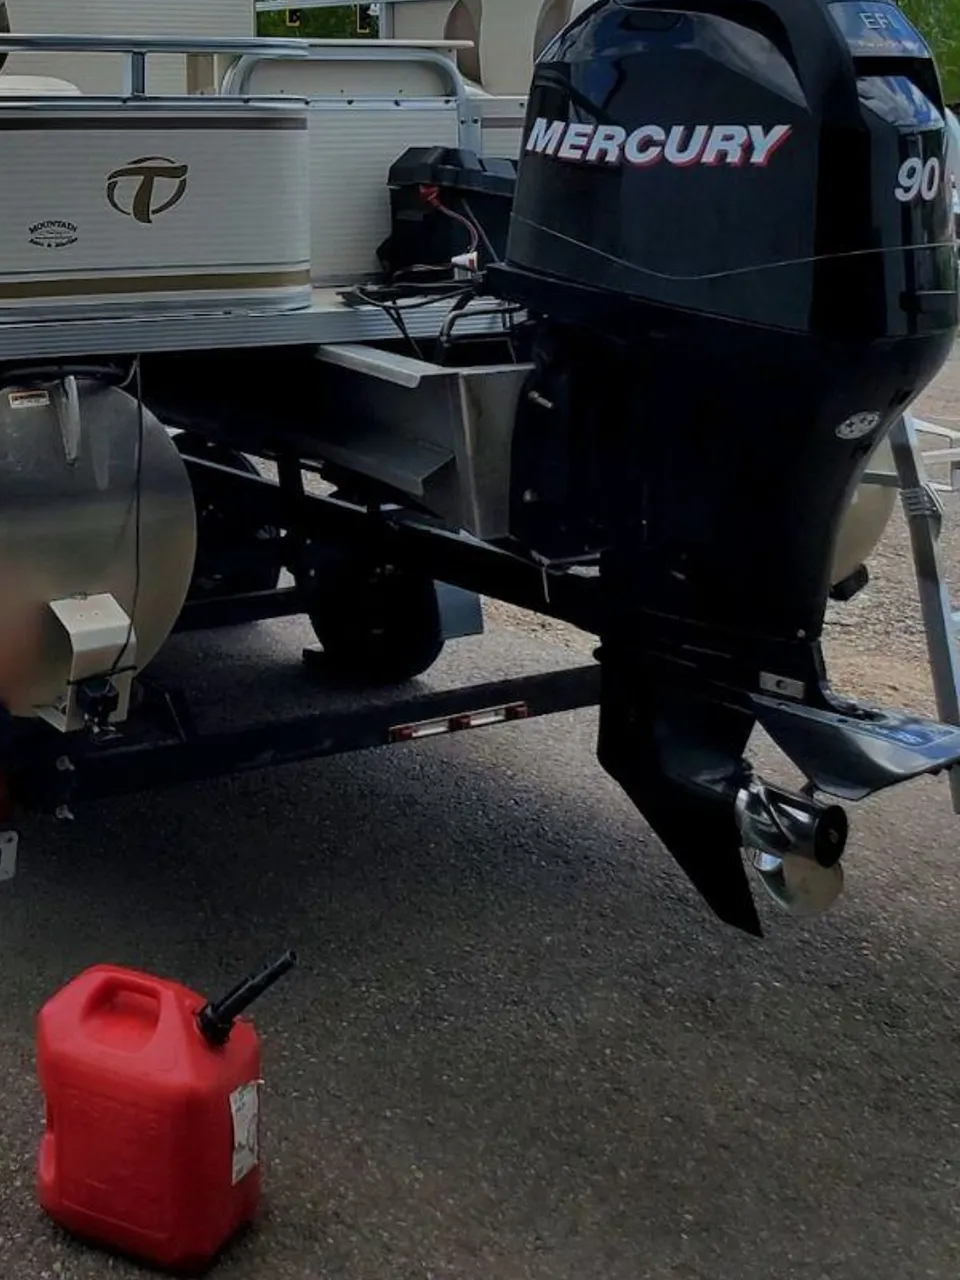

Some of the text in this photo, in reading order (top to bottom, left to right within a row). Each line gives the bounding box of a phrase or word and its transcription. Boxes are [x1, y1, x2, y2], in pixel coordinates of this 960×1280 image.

[859, 12, 899, 29] EFI
[526, 117, 792, 167] MERCURY
[107, 156, 188, 224] T
[894, 156, 940, 202] 90
[28, 220, 78, 234] MOUNTAIN
